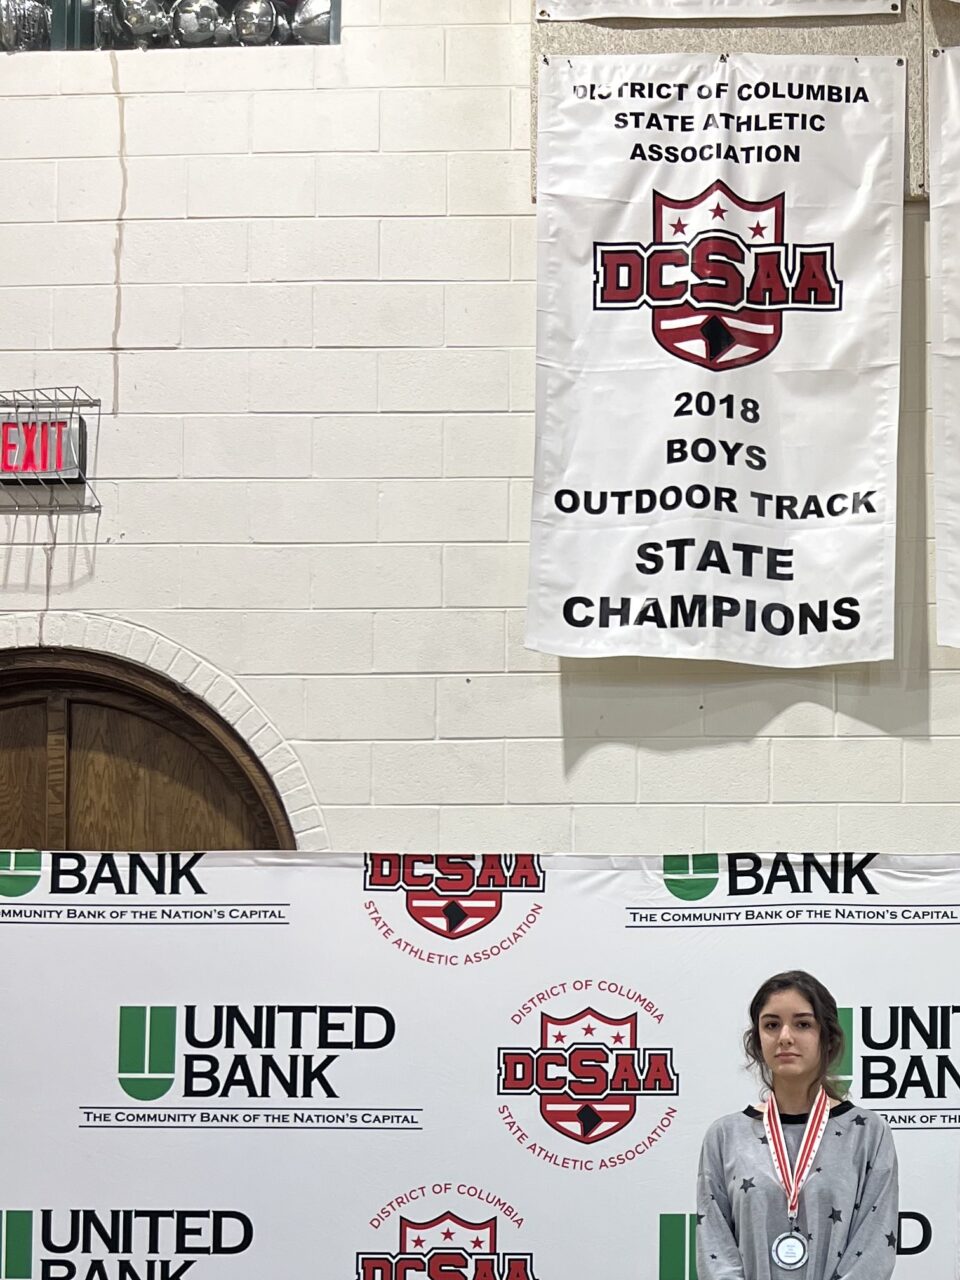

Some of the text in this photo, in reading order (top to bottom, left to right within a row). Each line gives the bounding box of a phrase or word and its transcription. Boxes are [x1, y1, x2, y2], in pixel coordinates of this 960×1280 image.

[697, 83, 728, 99] OF
[737, 82, 870, 103] COLUMBIA
[614, 112, 825, 132] STATE ATHLETIC
[629, 142, 801, 164] ASSOCIATION
[593, 230, 842, 312] DCSAA
[674, 392, 759, 423] 2018
[1, 420, 68, 472] EXIT
[667, 438, 766, 470] BOYS
[555, 484, 876, 519] OUTDOOR TRACK
[636, 538, 793, 580] STATE
[562, 595, 861, 637] CHAMPIONS
[49, 853, 208, 895] BANK
[365, 854, 544, 896] DCSAA
[726, 852, 880, 896] BANK
[363, 900, 544, 966] STATE ATHLETIC ASSOCIATION
[630, 909, 958, 921] THE COMMUNITY BANK OF THE NATION'S CAPITAL
[510, 979, 665, 1025] DISTRICT OF COLUMBIA
[185, 1005, 395, 1049] UNITED
[183, 1054, 339, 1098] BANK
[498, 1042, 679, 1100] DCSAA
[84, 1112, 418, 1123] THE COMMUNITY BANK OF THE NATION'S CAPITAL
[498, 1104, 677, 1171] STATE ATHLETIC ASSOCIATION
[369, 1183, 525, 1229] DISTRICT OF COLUMBIA
[41, 1209, 253, 1255] UNITED
